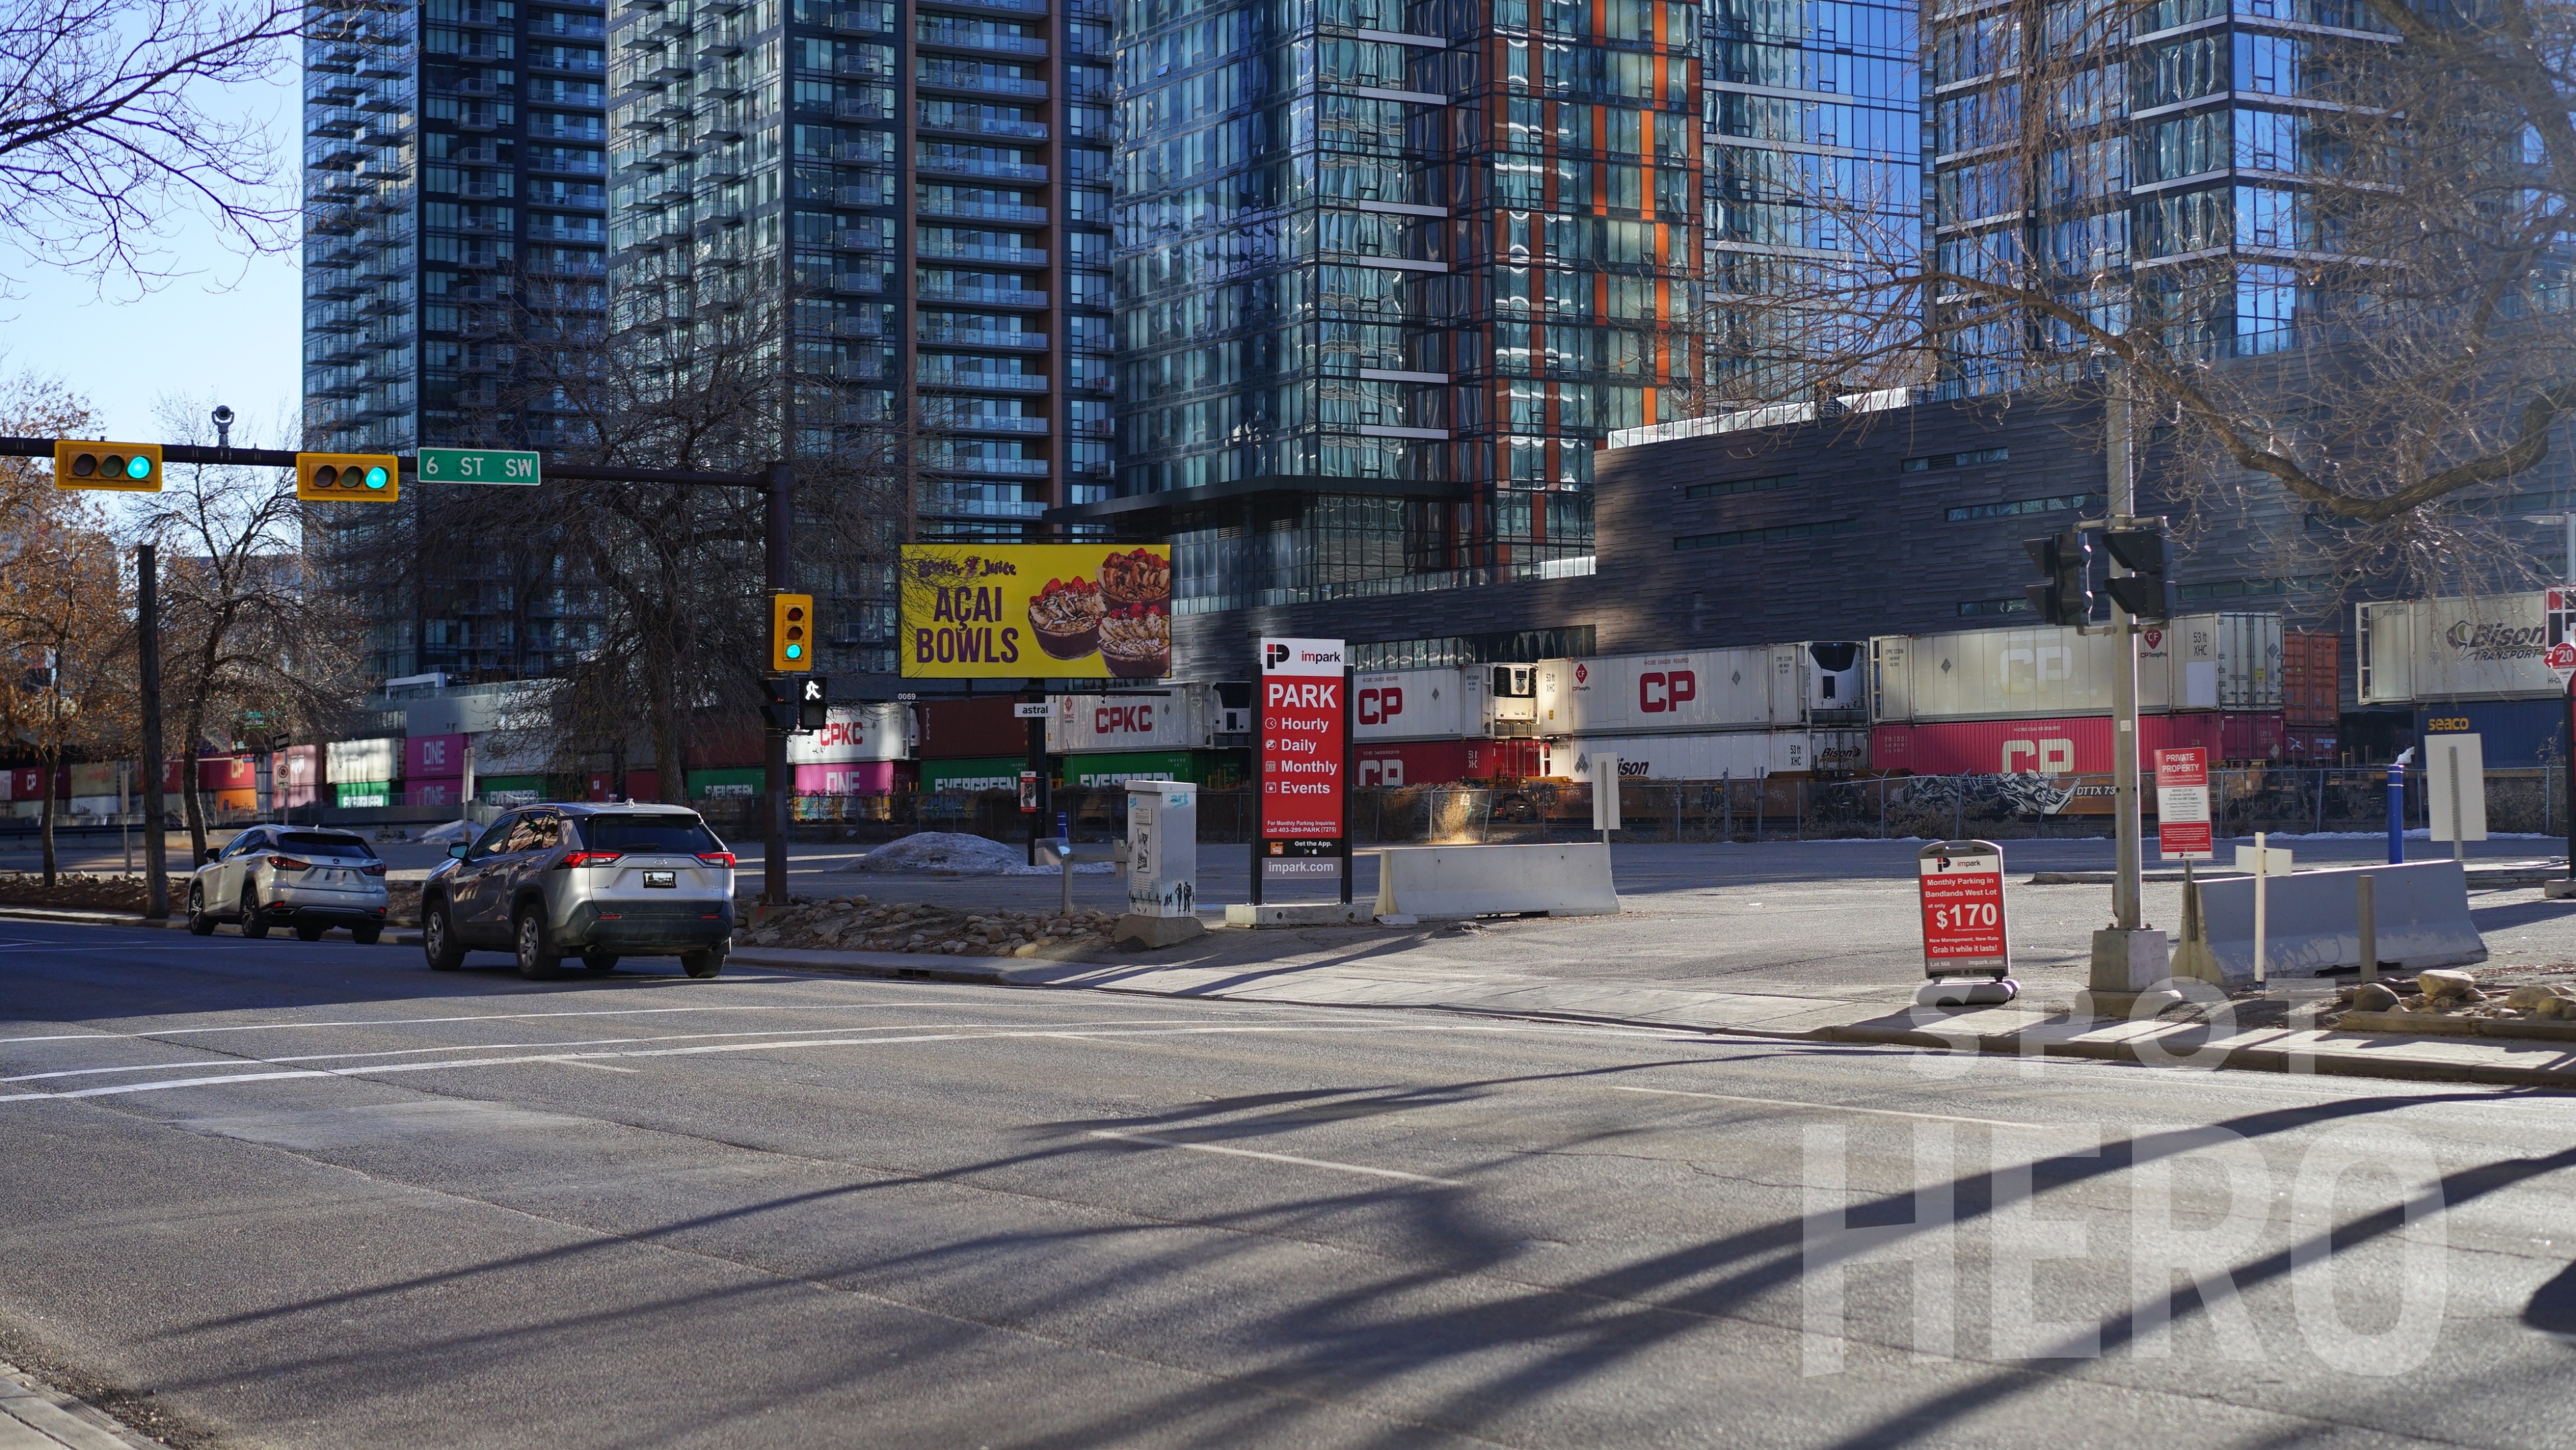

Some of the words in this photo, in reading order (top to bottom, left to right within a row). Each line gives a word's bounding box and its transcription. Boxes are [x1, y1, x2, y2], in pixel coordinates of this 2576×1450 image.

[426, 456, 439, 475] 6
[460, 457, 484, 476] ST
[505, 458, 533, 477] SW
[980, 559, 1017, 577] Juice
[933, 585, 1002, 632] AÇAI
[2193, 632, 2201, 643] 53
[2202, 631, 2207, 643] ft
[2469, 623, 2544, 647] Bison
[916, 627, 1019, 663] BOWLS
[2194, 645, 2207, 656] XHC
[1301, 651, 1341, 665] impark
[2473, 648, 2540, 661] TRANSPORT
[2555, 649, 2574, 663] $20
[1546, 673, 1551, 682] 53
[1552, 673, 1555, 681] ft
[1999, 646, 2072, 694] CP
[1269, 683, 1337, 708] PARK
[1546, 684, 1555, 692] XHC
[1640, 670, 1696, 713] CP
[1022, 705, 1049, 714] astral
[1358, 687, 1403, 725] CP
[1095, 705, 1152, 734] CPKC
[1281, 717, 1329, 733] Hourly
[2428, 717, 2469, 732] seaco
[820, 722, 863, 746] CPKC
[423, 740, 445, 765] ONE
[1281, 738, 1317, 754] Daily
[1790, 745, 1796, 755] 53
[1797, 745, 1801, 755] ft
[1821, 747, 1854, 757] Bison
[1790, 756, 1801, 766] XHC
[2002, 738, 2074, 773] CP
[2165, 752, 2195, 763] PRIVATE
[1281, 760, 1338, 776] Monthly
[1358, 759, 1403, 786] CP
[1617, 758, 1650, 776] ison
[2161, 763, 2200, 773] PROPERTY
[826, 771, 860, 796] ONE
[1281, 781, 1330, 794] Events
[2077, 786, 2102, 795] DTTX
[423, 785, 445, 805] ONE
[1171, 792, 1189, 803] art
[1269, 861, 1334, 875] impark.com
[1936, 903, 1997, 930] $170
